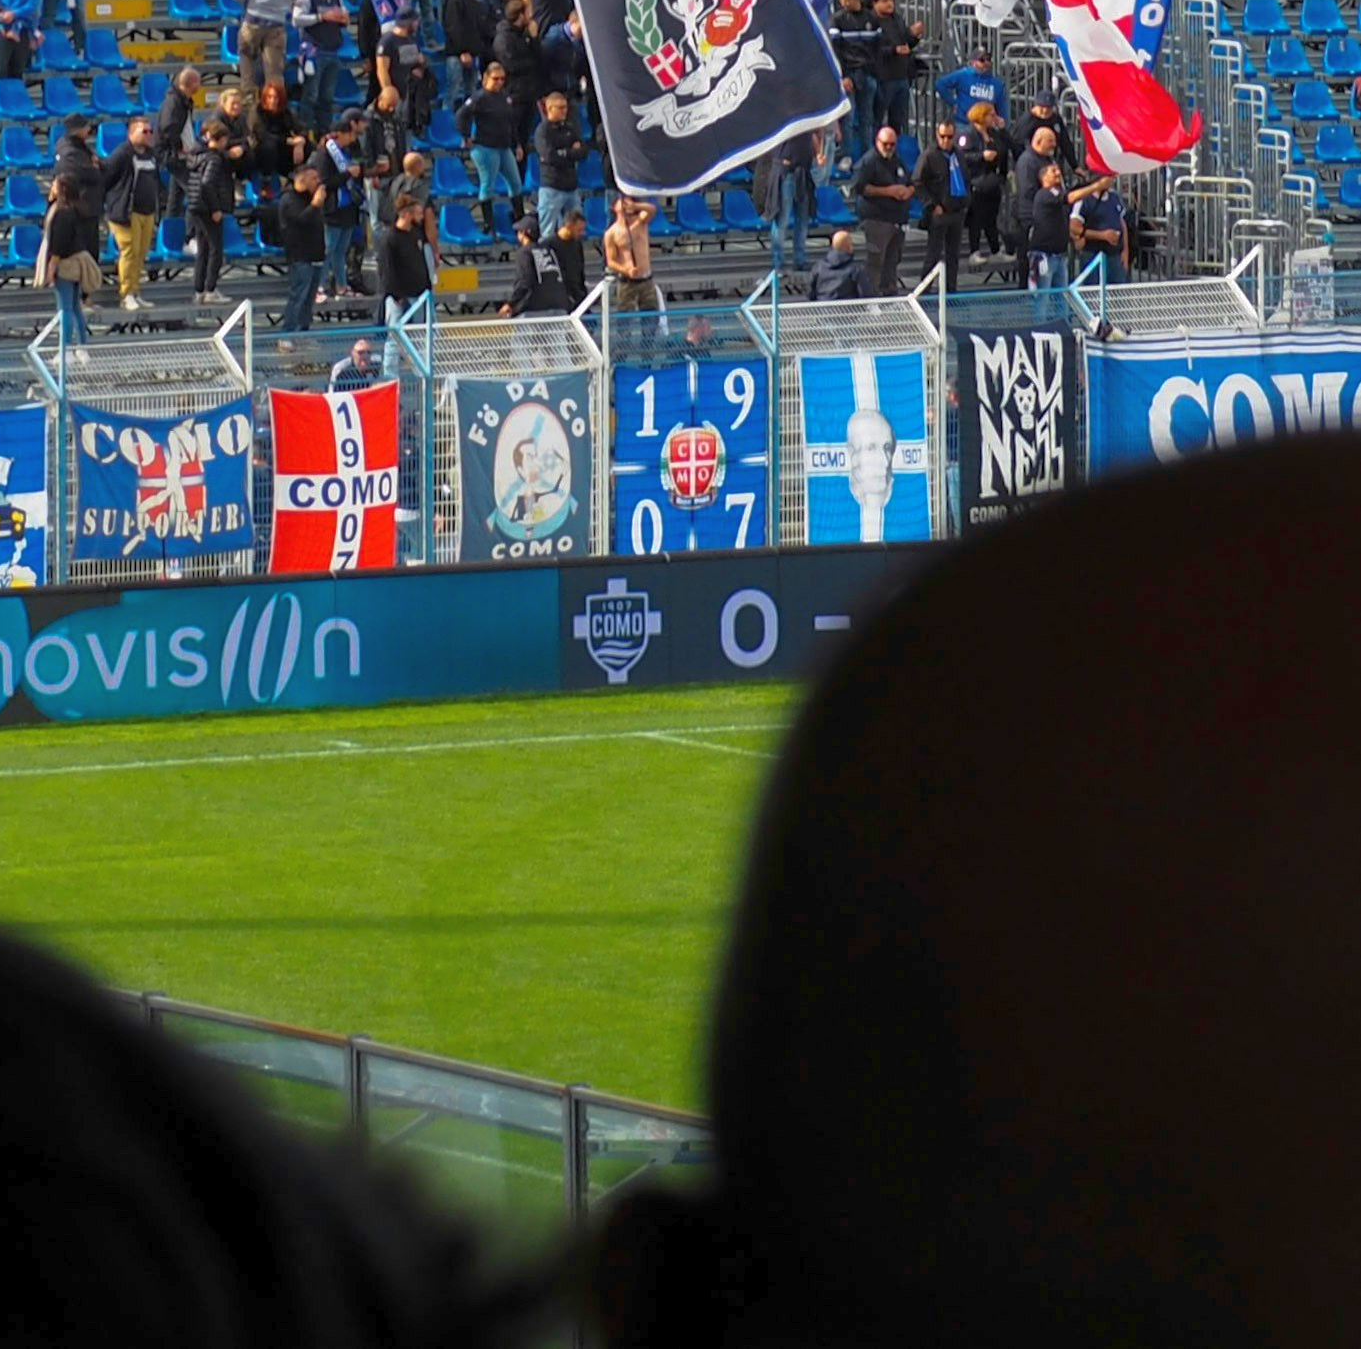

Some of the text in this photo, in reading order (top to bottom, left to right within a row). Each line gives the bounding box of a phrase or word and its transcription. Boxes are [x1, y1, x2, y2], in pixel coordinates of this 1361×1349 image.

[969, 331, 1064, 413] MAD
[506, 380, 549, 403] DA
[1148, 372, 1361, 465] COM
[80, 413, 251, 465] COMO
[811, 447, 923, 468] COMO 1907
[290, 470, 392, 508] COMO
[491, 536, 573, 560] COMO
[591, 612, 644, 639] COMO
[720, 589, 779, 668] 0
